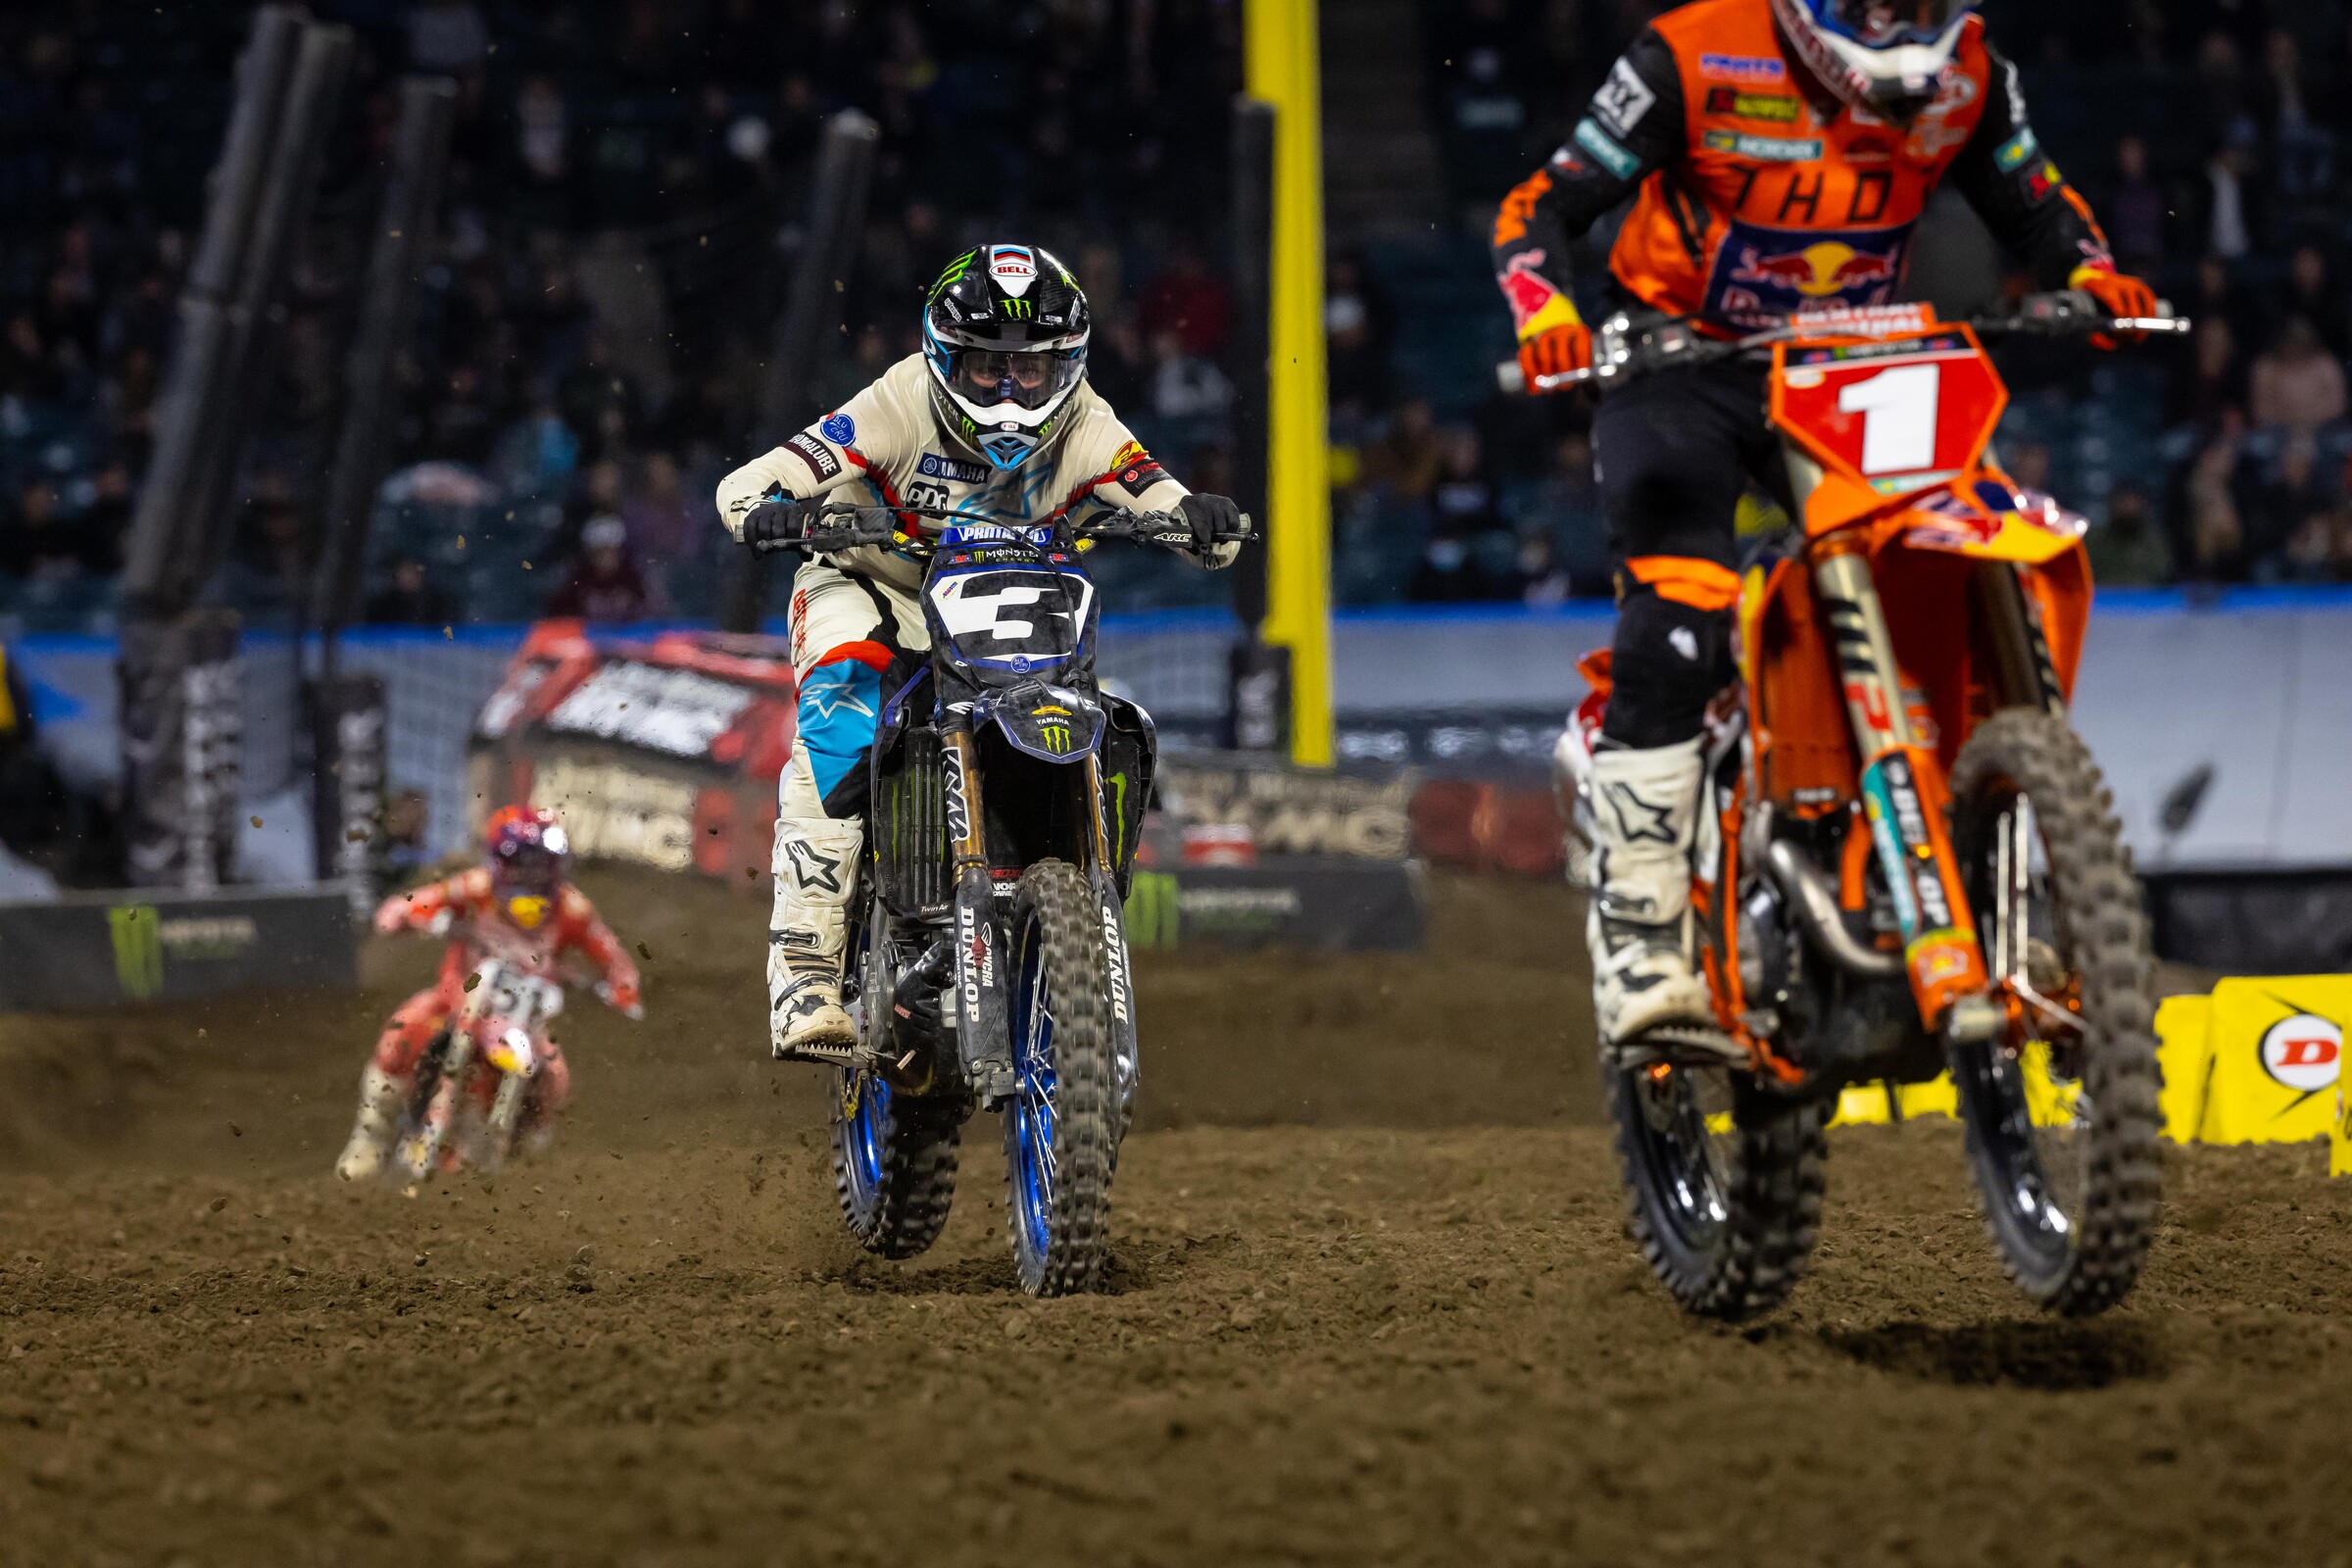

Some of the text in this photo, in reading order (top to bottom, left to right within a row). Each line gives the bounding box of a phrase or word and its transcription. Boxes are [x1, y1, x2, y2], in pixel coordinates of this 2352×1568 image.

[997, 266, 1031, 274] BELL
[833, 416, 848, 428] BLU
[1838, 364, 1940, 474] 1
[830, 426, 849, 441] CRU
[938, 459, 985, 483] AMAHA
[1153, 532, 1193, 542] ARC
[986, 548, 1039, 558] MONSTE
[953, 570, 1085, 659] 3
[1036, 716, 1070, 726] YAMAHA
[960, 906, 980, 1023] DUNLOP
[1102, 906, 1129, 1025] DUNLOP
[2275, 1039, 2339, 1067] D
